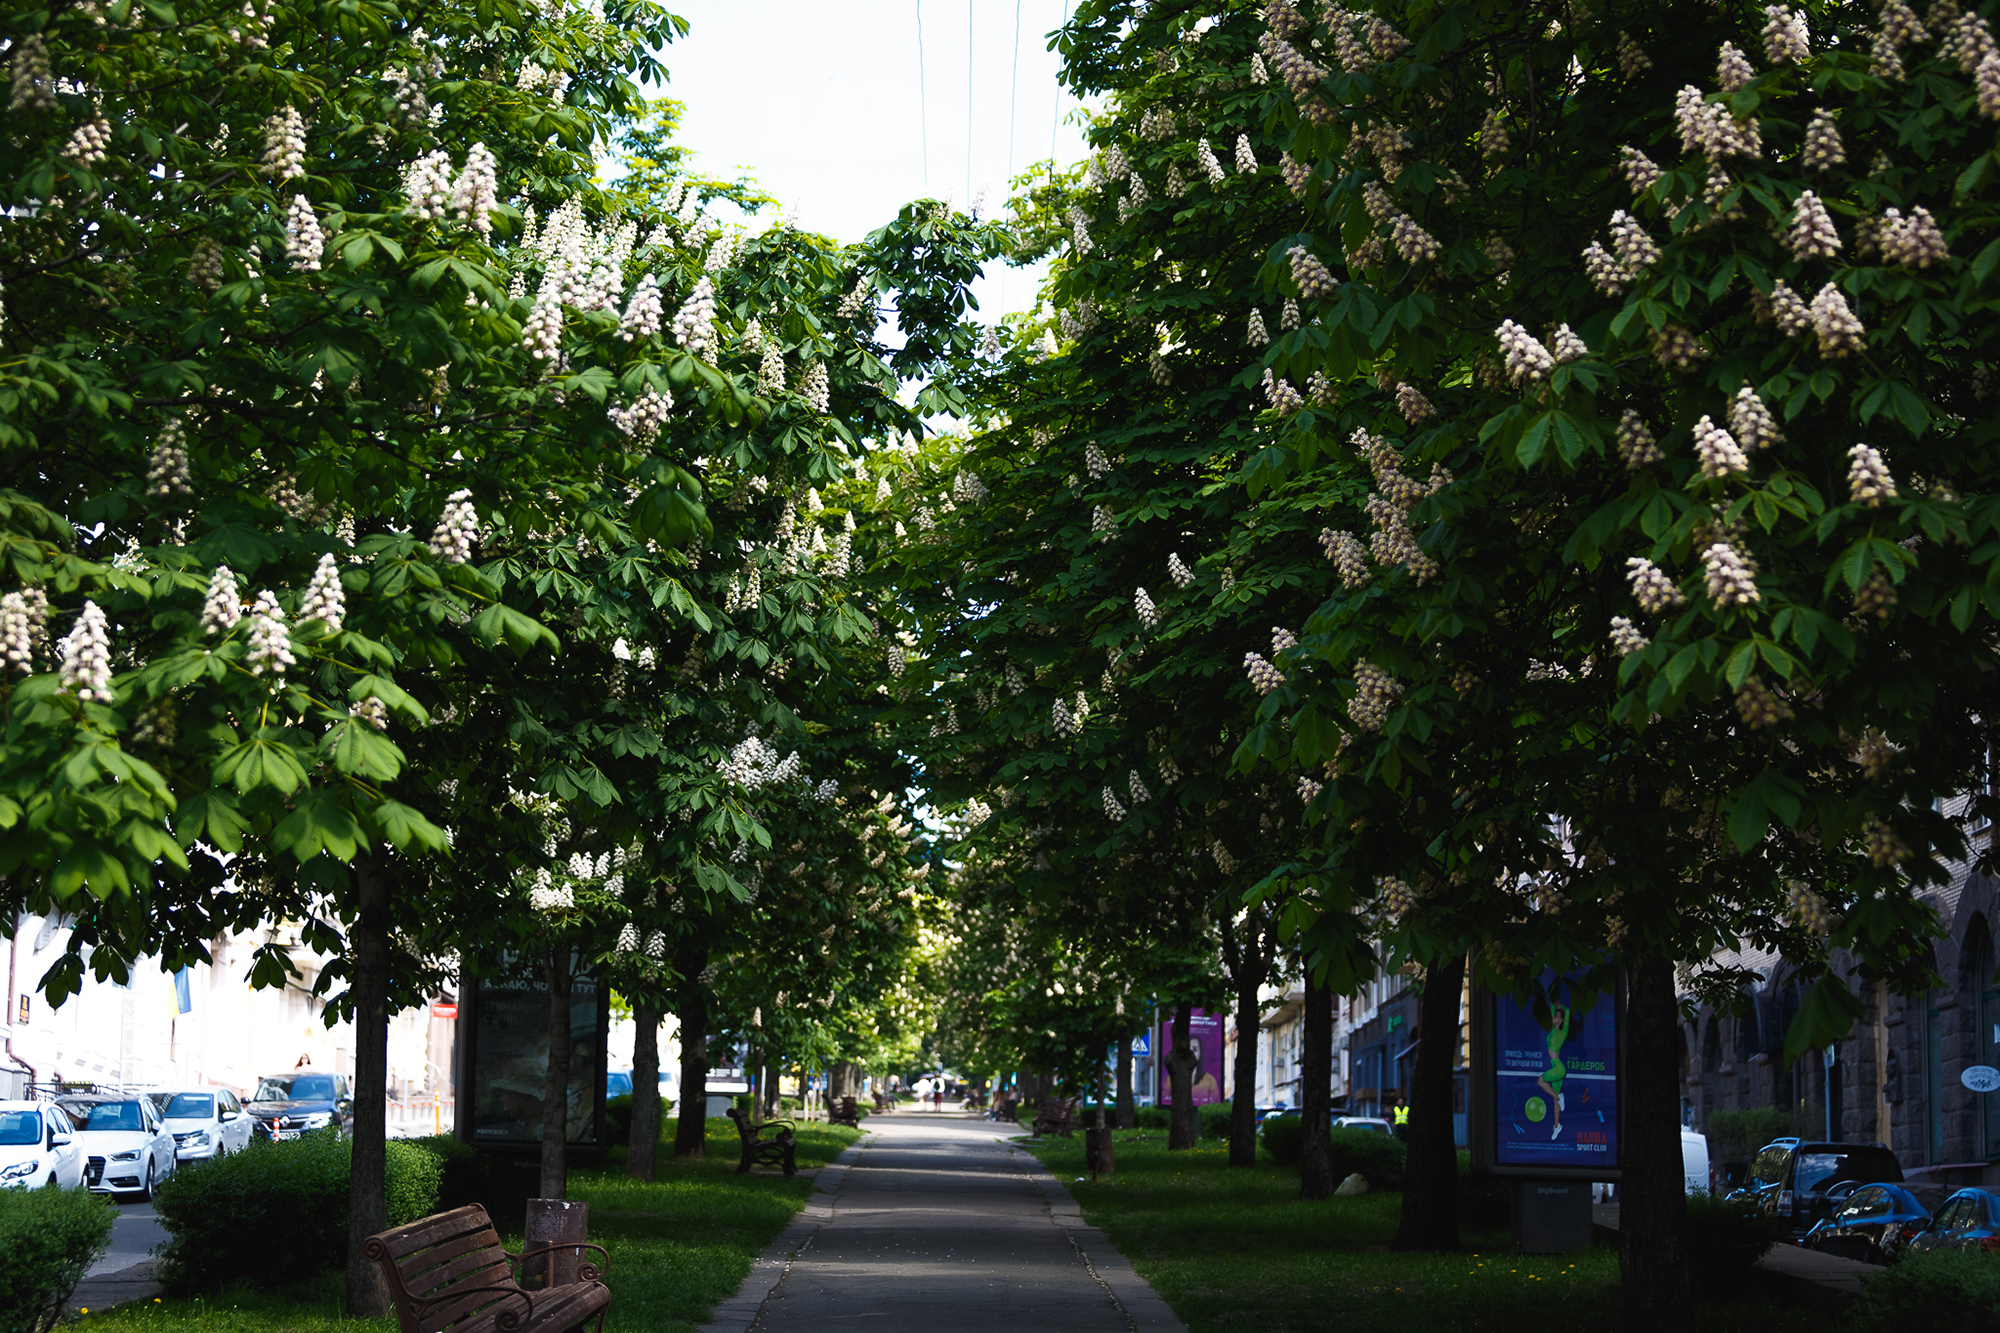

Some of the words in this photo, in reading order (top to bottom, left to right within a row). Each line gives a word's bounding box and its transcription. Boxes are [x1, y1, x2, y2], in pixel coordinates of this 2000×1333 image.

[577, 984, 597, 993] ТУТ
[484, 1001, 542, 1014] ТРИМАЙМО
[1567, 1061, 1605, 1071] ГАРДЕРОБ
[1577, 1132, 1607, 1144] BANDA
[1537, 1187, 1569, 1195] BigBoard
